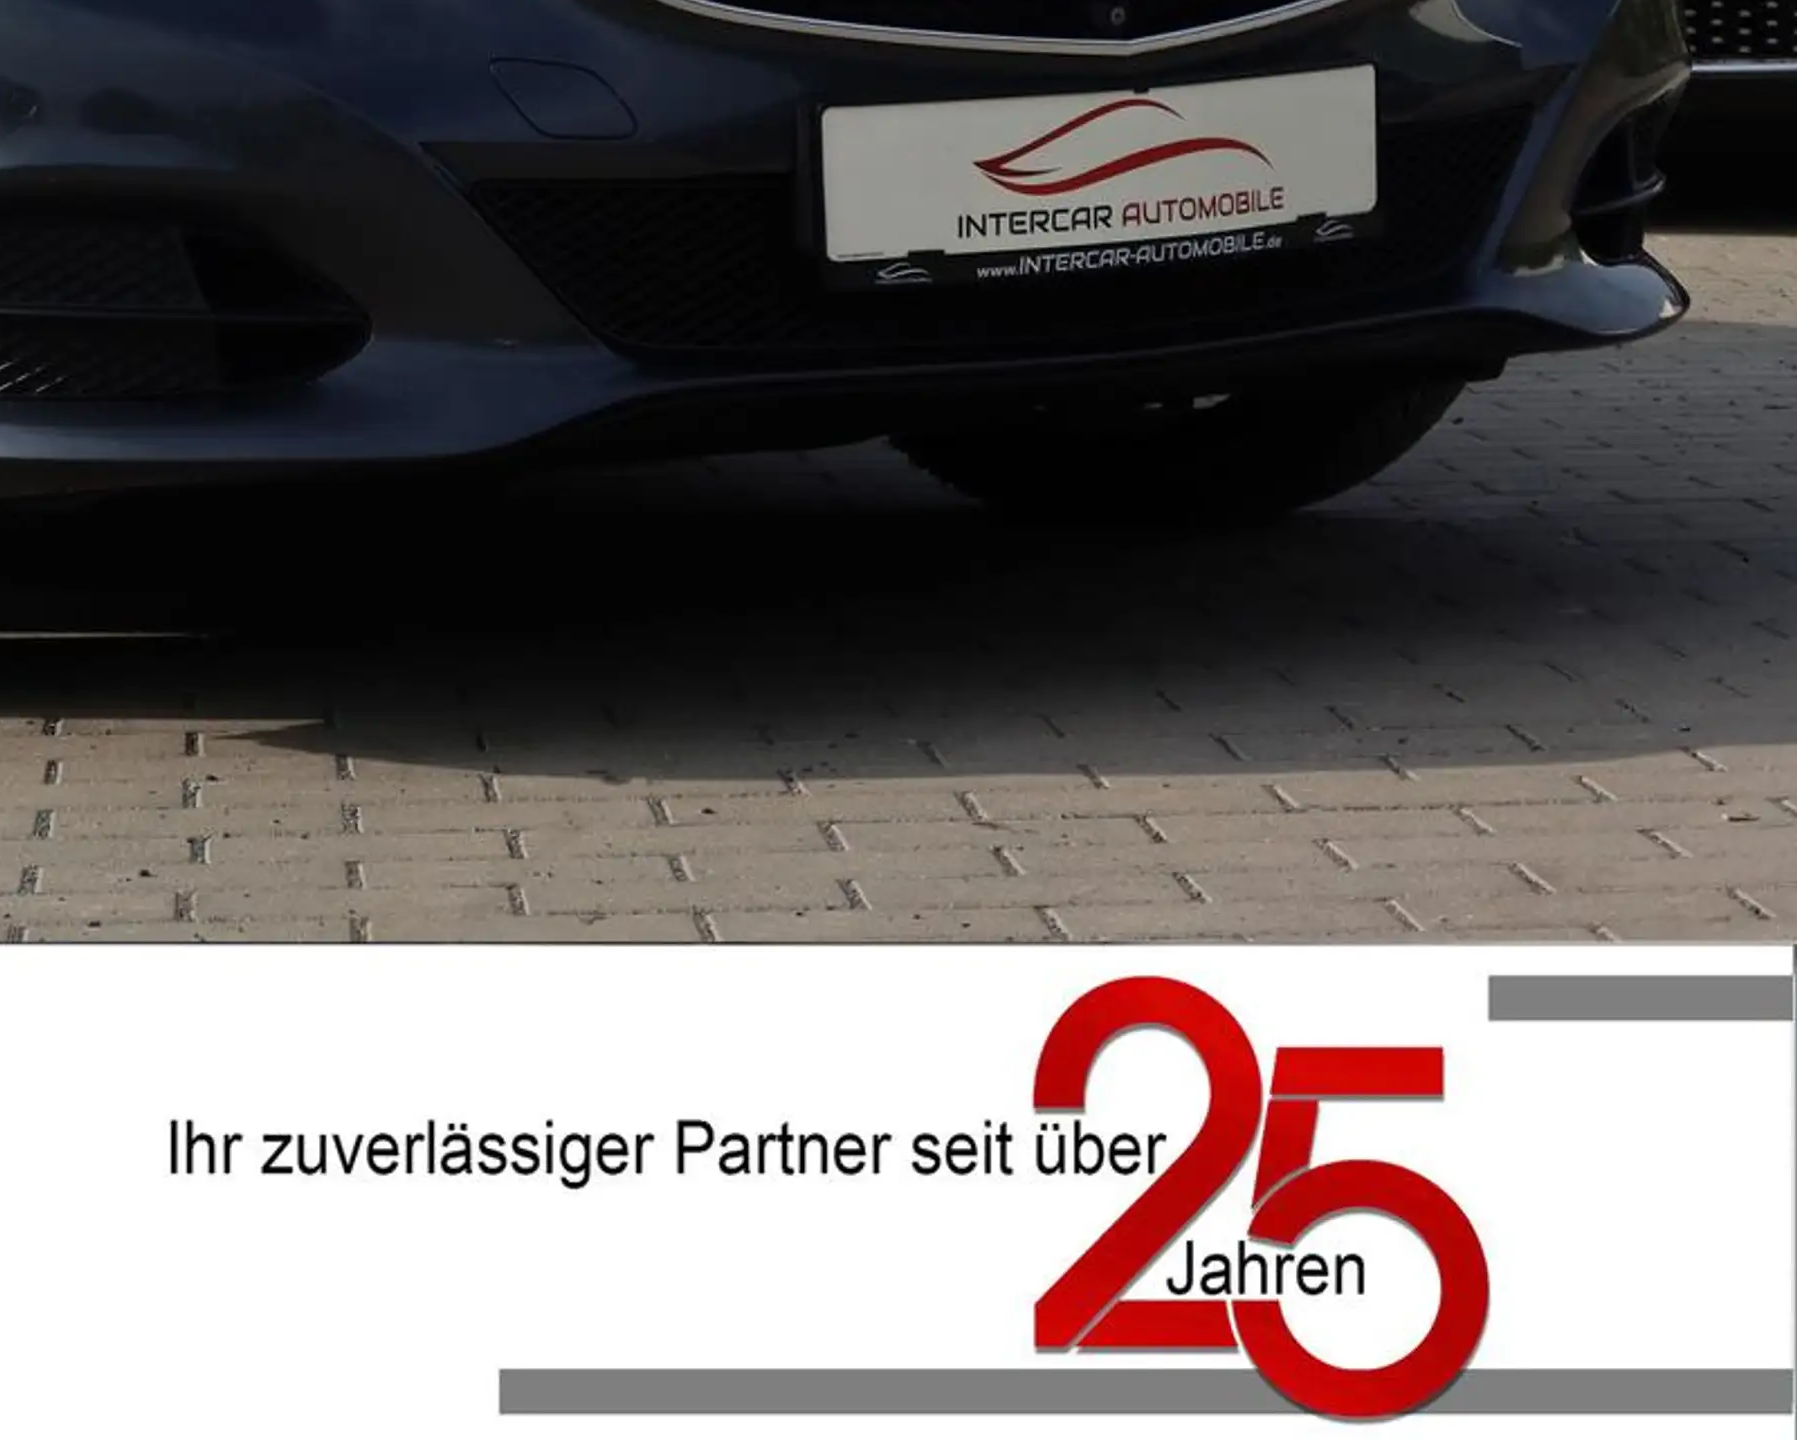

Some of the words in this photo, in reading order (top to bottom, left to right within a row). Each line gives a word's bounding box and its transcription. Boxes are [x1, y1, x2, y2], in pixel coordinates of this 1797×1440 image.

[957, 205, 1113, 238] INTERCAR
[1121, 186, 1285, 227] AUTOMOBILE
[976, 232, 1283, 278] www.INTERCAR-AUTOMOBILE.de
